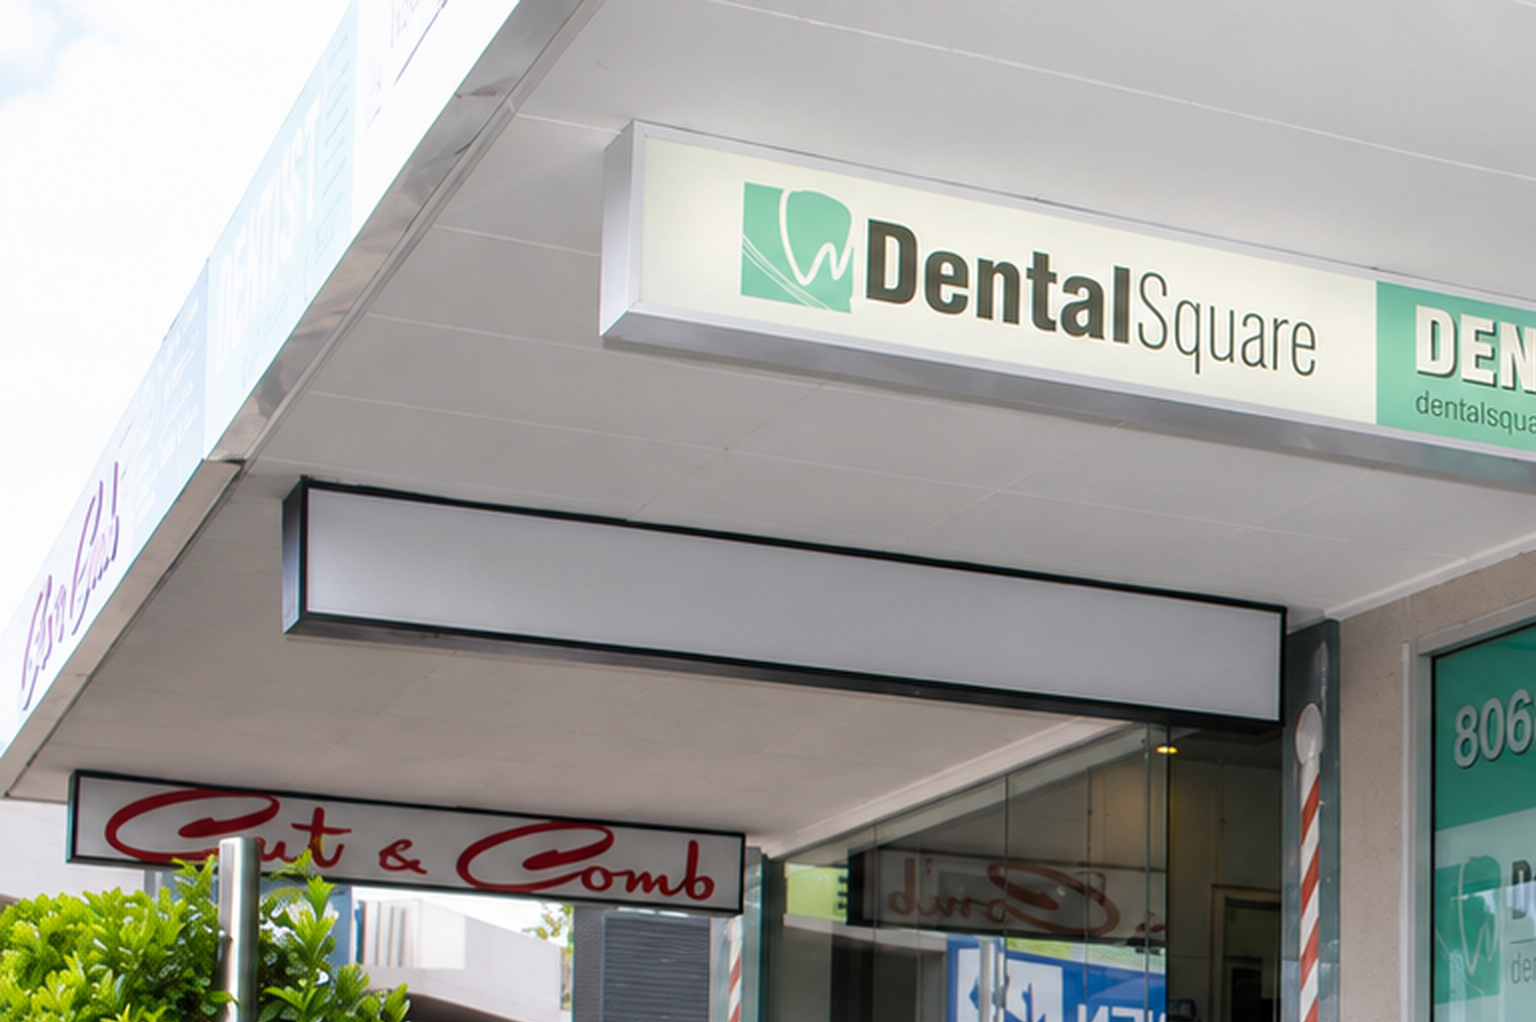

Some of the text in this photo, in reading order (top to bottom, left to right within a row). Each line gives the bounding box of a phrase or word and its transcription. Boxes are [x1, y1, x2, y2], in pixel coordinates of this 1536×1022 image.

[865, 217, 1317, 376] DentalSquare
[377, 838, 429, 875] &
[456, 820, 716, 902] Comb
